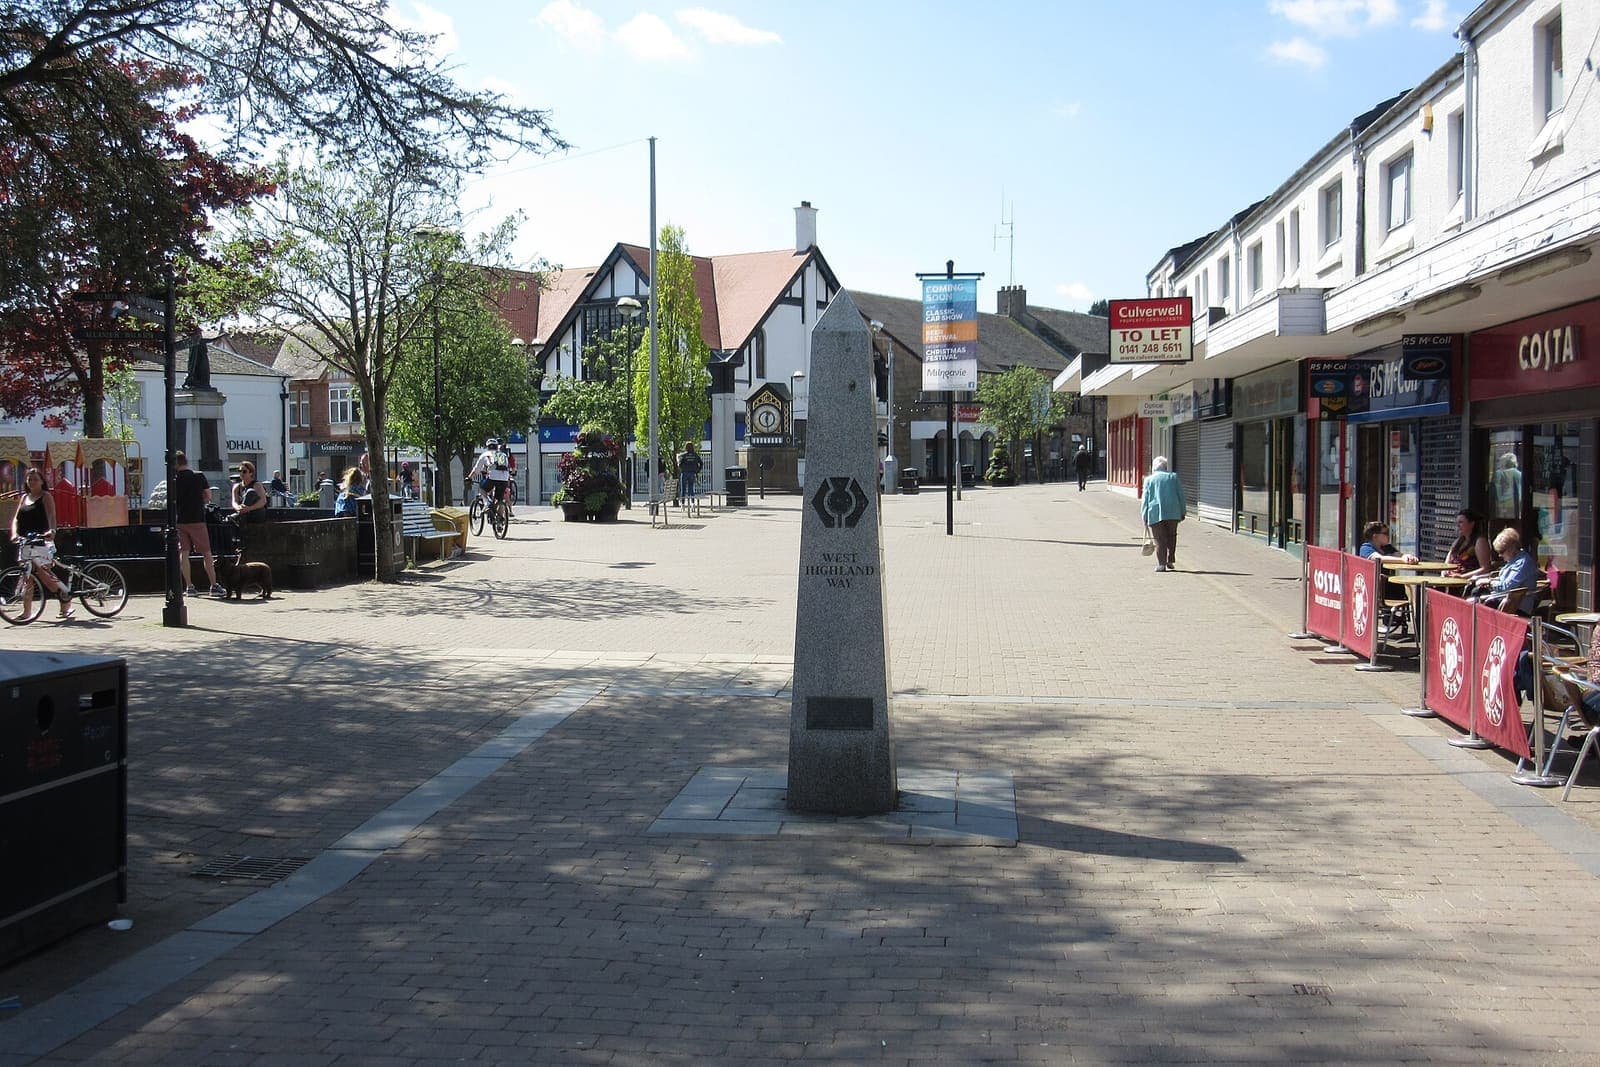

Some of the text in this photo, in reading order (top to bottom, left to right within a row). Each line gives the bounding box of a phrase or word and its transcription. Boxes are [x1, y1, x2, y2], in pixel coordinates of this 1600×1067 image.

[925, 284, 964, 293] COMING
[925, 293, 953, 302] SOON
[1118, 304, 1183, 318] Culverwell
[925, 313, 963, 323] CAR SHOW
[1119, 328, 1182, 342] TO LET
[1402, 336, 1416, 345] RS
[925, 347, 967, 355] CHRISTMAS
[1119, 342, 1182, 354] 0141 248 6611
[1518, 325, 1574, 371] COSTA
[925, 353, 958, 361] FESTIVAL
[926, 368, 967, 379] Milngavie
[1369, 363, 1384, 398] RS
[821, 552, 858, 563] WEST
[804, 565, 875, 576] HIGHLAND
[826, 578, 852, 588] WAY
[1313, 569, 1341, 594] COSTA
